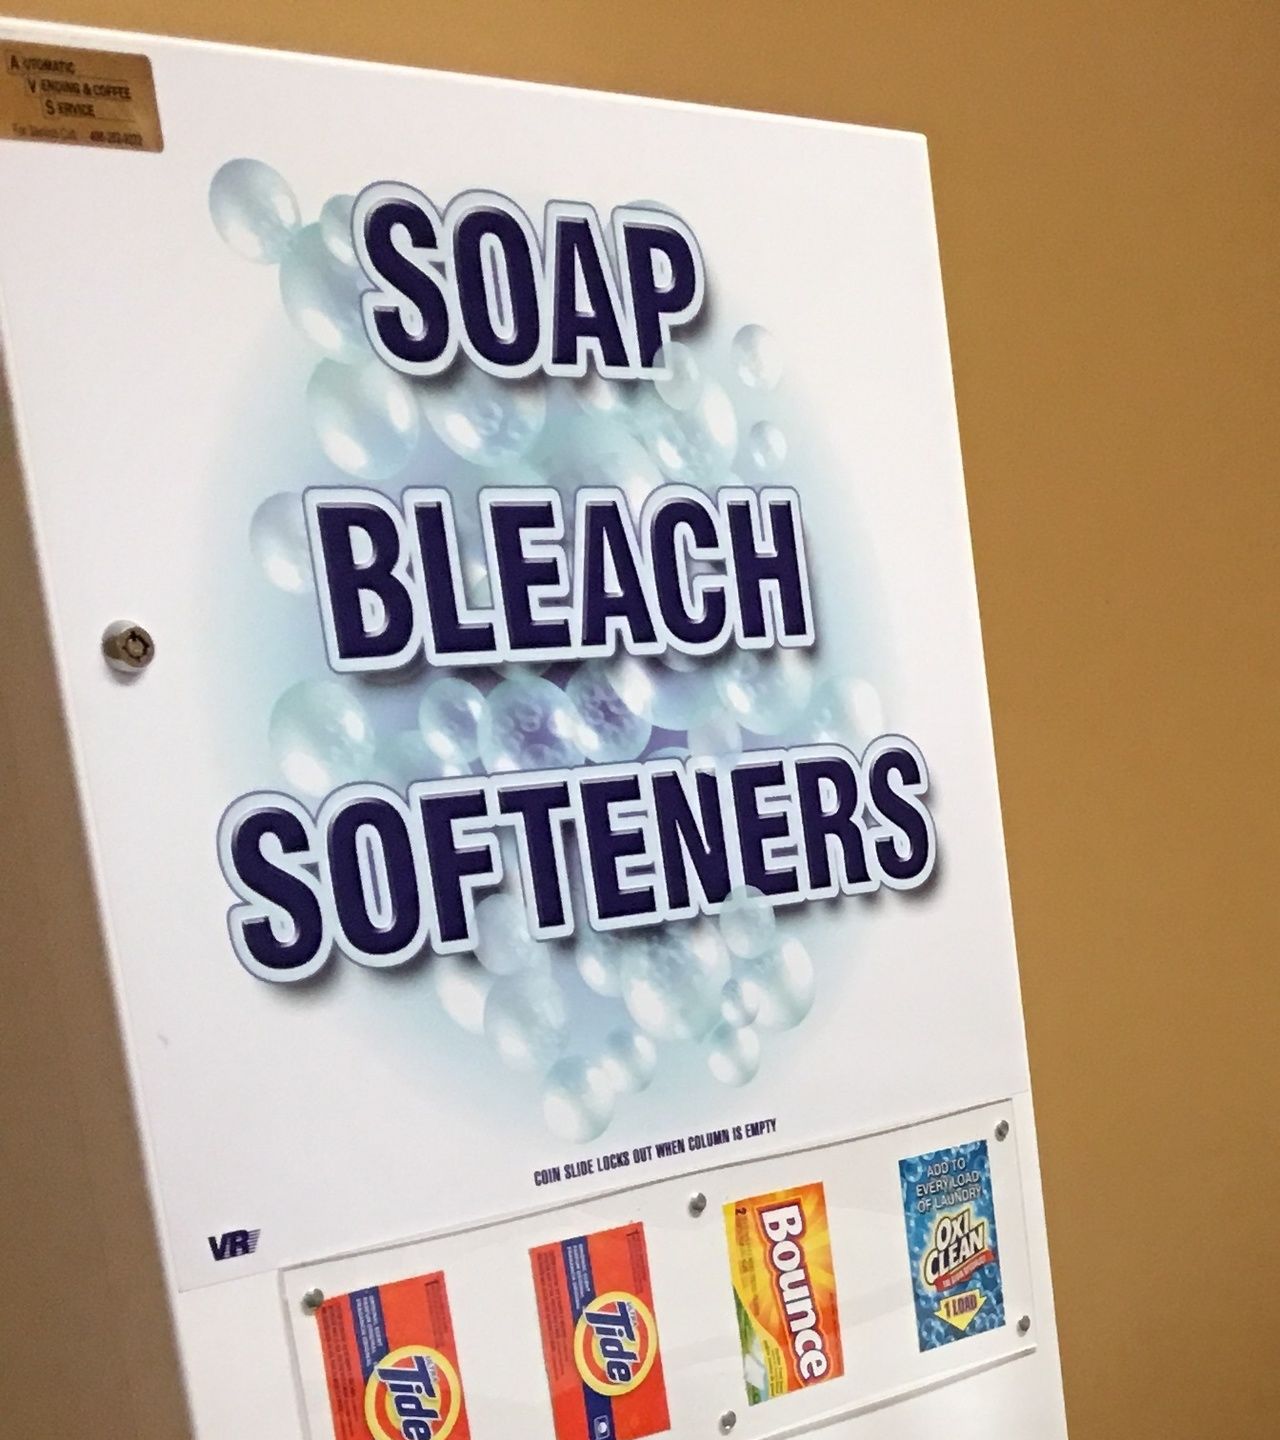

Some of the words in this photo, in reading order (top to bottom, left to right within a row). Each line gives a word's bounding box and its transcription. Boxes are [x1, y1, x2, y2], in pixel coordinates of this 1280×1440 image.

[93, 85, 131, 99] COFFEE
[360, 199, 699, 370] SOAP
[313, 497, 809, 662] BLEACH
[229, 744, 931, 973] SOFTENERS
[533, 1168, 561, 1187] COIN
[564, 1160, 594, 1180] SLIDE
[597, 1152, 630, 1172] LOCKS
[633, 1145, 653, 1164] OUT
[655, 1138, 685, 1159] WHEN
[688, 1128, 730, 1151] COLUMN
[732, 1125, 743, 1141] IS
[745, 1118, 777, 1138] EMPTY
[916, 1178, 950, 1197] EVERY
[951, 1171, 980, 1189] LOAD
[926, 1161, 949, 1178] ADD
[951, 1157, 966, 1171] TO
[917, 1198, 933, 1213] OF
[934, 1186, 982, 1210] LAUNDRY
[936, 1208, 970, 1248] OXI
[924, 1222, 986, 1286] CLEAN
[762, 1204, 828, 1380] Bounce
[952, 1294, 977, 1317] LOAD
[584, 1300, 637, 1383] Tide
